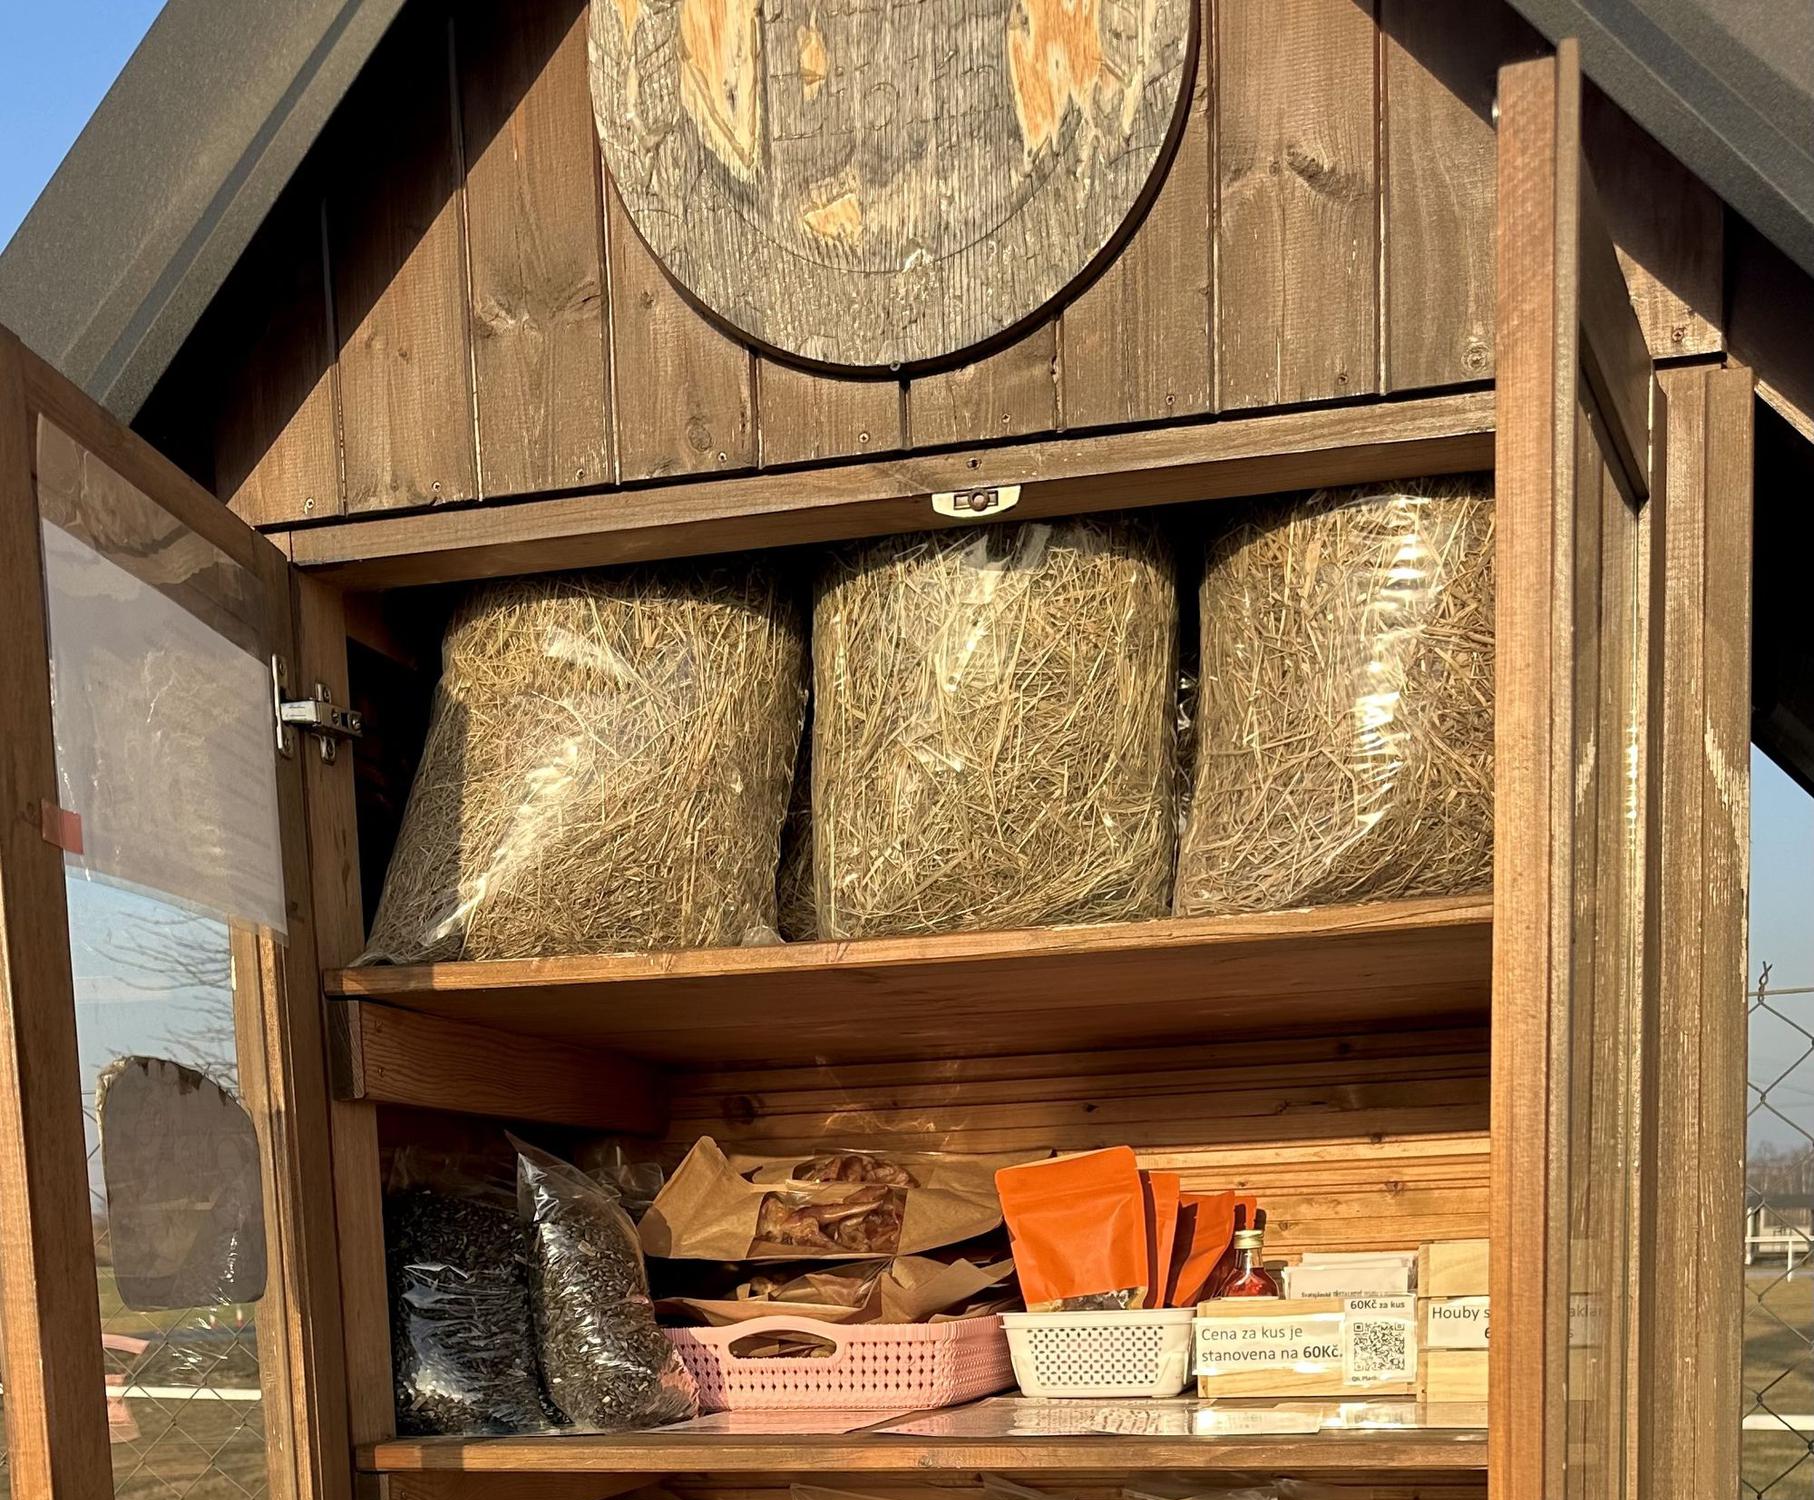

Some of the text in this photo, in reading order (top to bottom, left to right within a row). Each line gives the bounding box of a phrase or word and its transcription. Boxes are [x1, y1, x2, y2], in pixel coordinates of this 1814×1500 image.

[1350, 1299, 1377, 1310] 60Kč
[1390, 1300, 1405, 1309] kus
[1432, 1305, 1480, 1321] Houby
[1201, 1325, 1303, 1341] Cena za kus je
[1201, 1344, 1343, 1362] stanovena na 60Kč.
